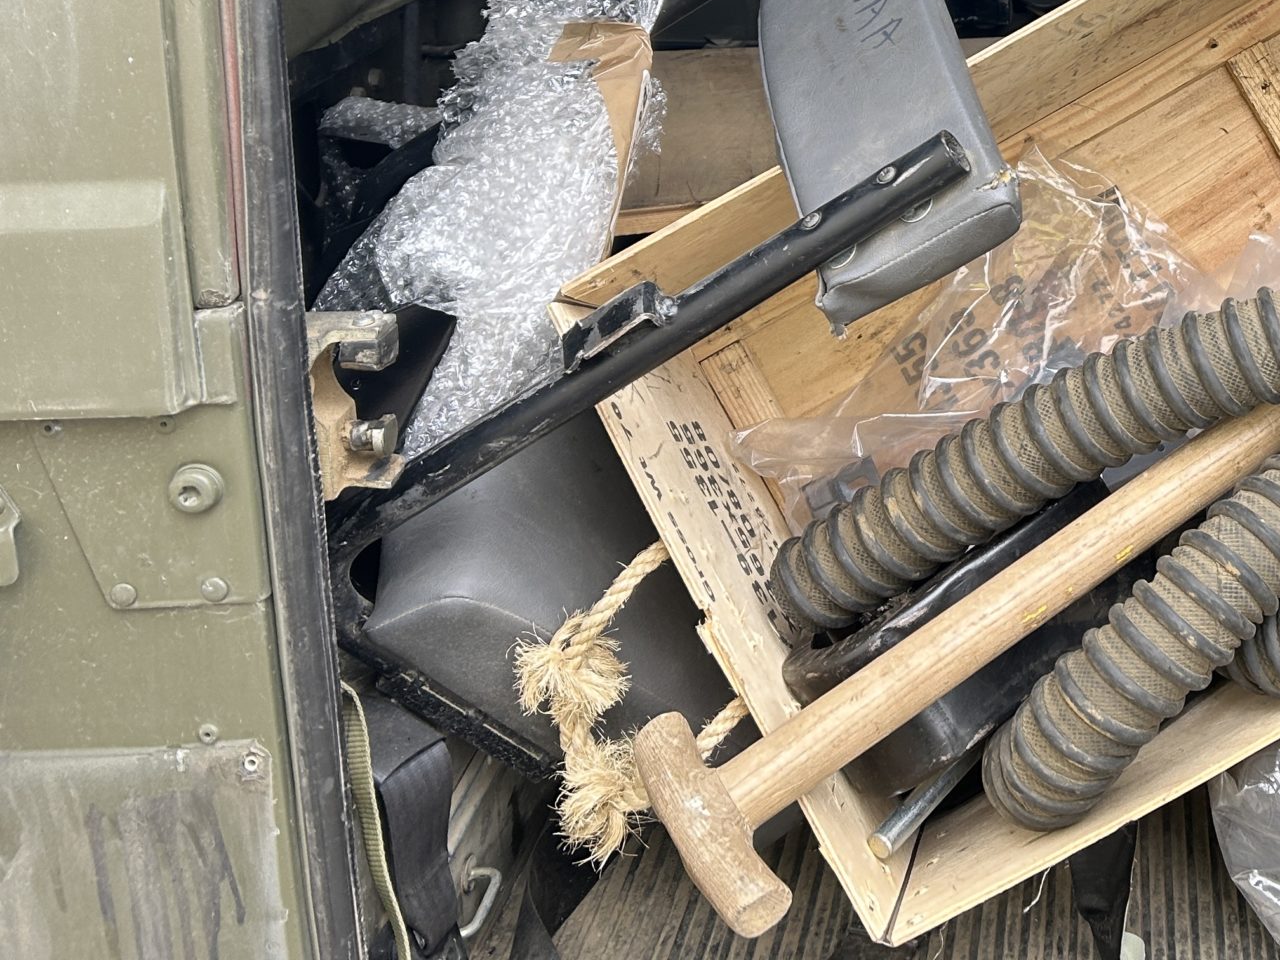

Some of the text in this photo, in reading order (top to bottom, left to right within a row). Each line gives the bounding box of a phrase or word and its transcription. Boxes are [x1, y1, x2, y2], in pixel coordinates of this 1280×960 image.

[611, 401, 715, 602] Gross Wt 70
